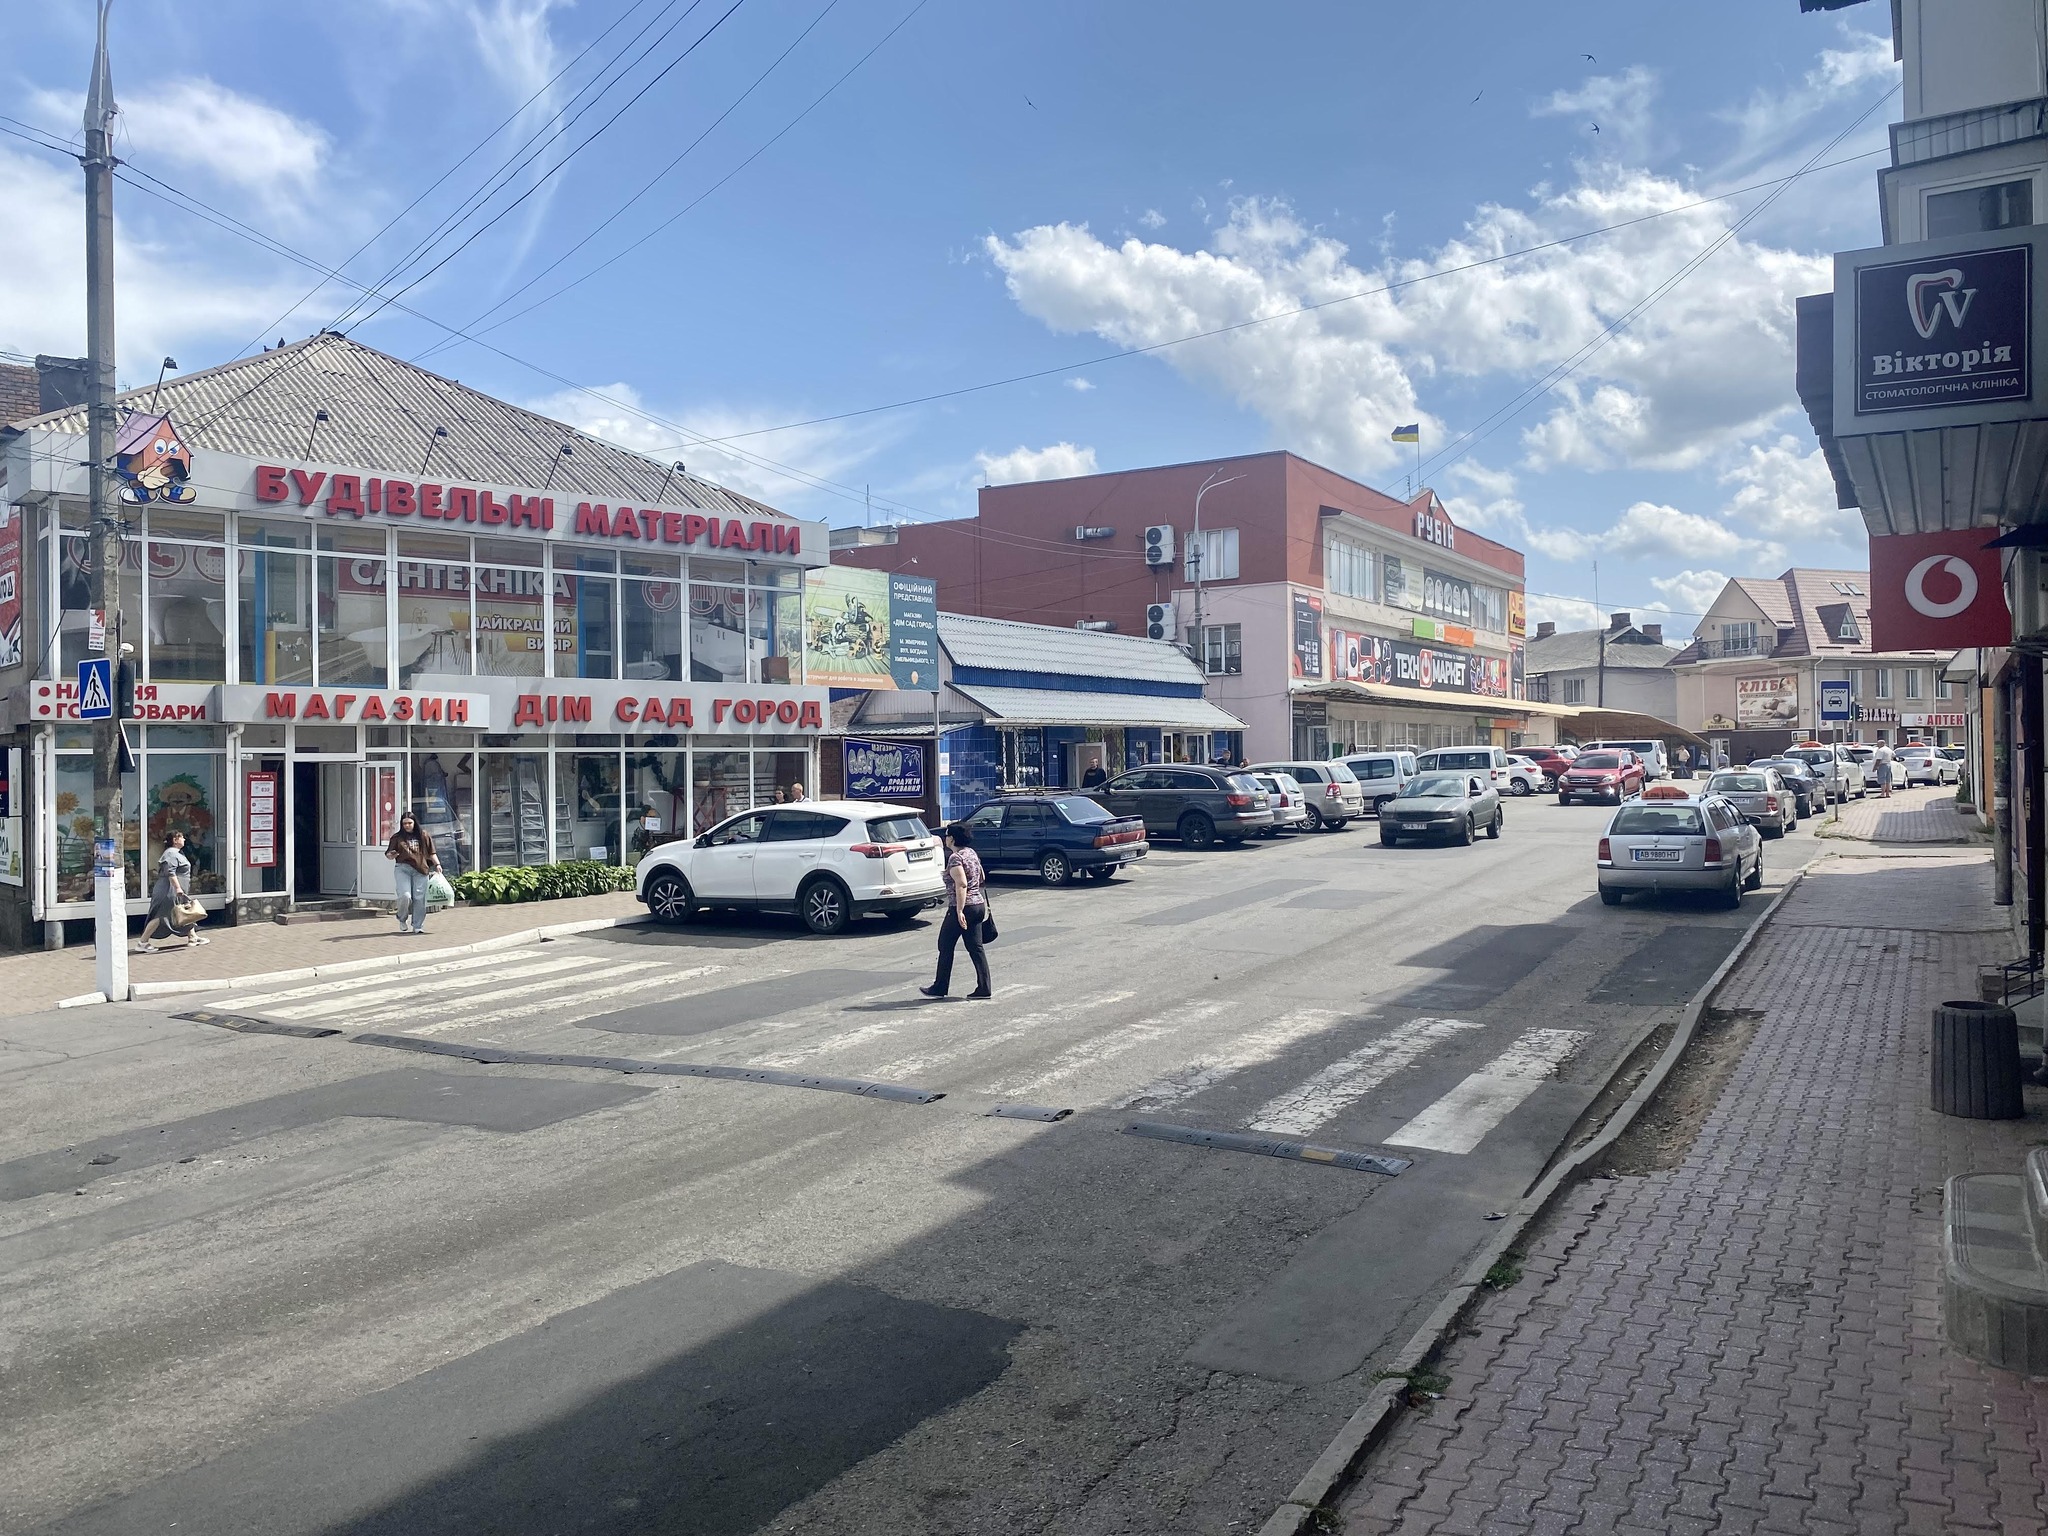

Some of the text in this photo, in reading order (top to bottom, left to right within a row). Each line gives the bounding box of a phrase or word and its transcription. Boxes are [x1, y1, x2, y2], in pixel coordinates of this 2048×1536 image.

[1873, 340, 2012, 376] Вікторія
[1865, 377, 2019, 400] СТОМАТОЛОГІЧНА КЛІНІКА
[256, 465, 801, 555] БУДІВЕЛЬНІ МАТЕРІАЛИ
[1417, 511, 1455, 549] РУБІН
[350, 559, 571, 599] САНТЕХНІКА
[893, 581, 933, 595] ОФІЦІЙНИЙ
[893, 593, 933, 603] ПРЕДСТАВНИК
[1739, 680, 1779, 693] ХЛІБ
[266, 692, 470, 723] МАГАЗИН
[514, 694, 823, 729] ДІМ САД ГОРОД
[1927, 714, 1963, 726] АПТЕК
[879, 785, 921, 793] ХАРЧУВАННЯ
[888, 778, 921, 786] ПРОДУКТИ
